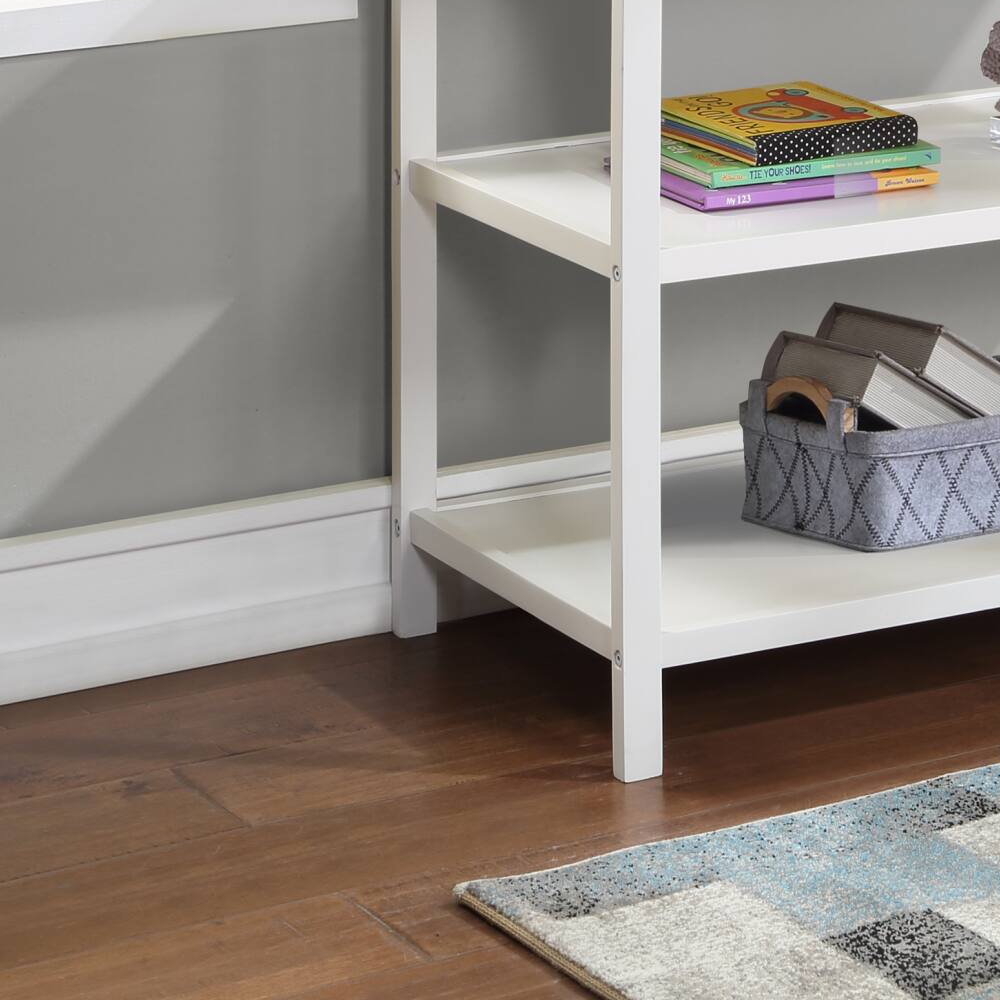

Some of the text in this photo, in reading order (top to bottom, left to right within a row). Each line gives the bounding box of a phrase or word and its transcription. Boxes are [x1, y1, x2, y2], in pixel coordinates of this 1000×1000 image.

[750, 170, 763, 180] TIE
[765, 167, 784, 178] YOUR
[785, 164, 812, 176] SHOES!
[726, 193, 752, 205] My 123
